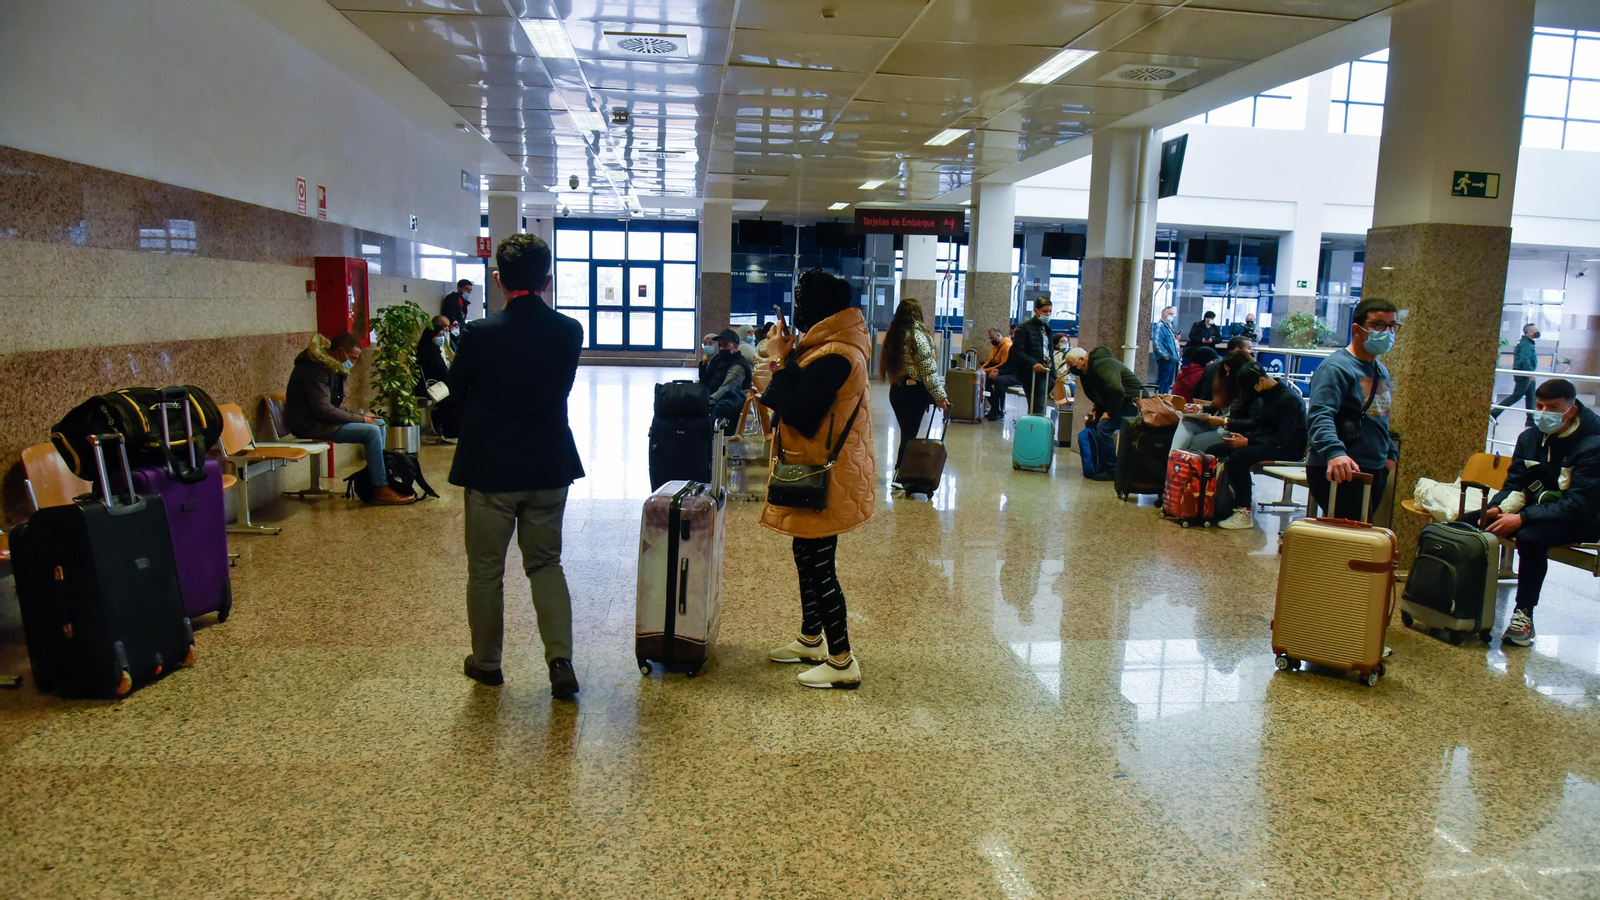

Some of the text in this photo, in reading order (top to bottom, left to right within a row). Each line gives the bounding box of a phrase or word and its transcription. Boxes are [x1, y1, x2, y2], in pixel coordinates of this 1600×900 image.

[862, 216, 936, 228] Tarjetas de Embarque
